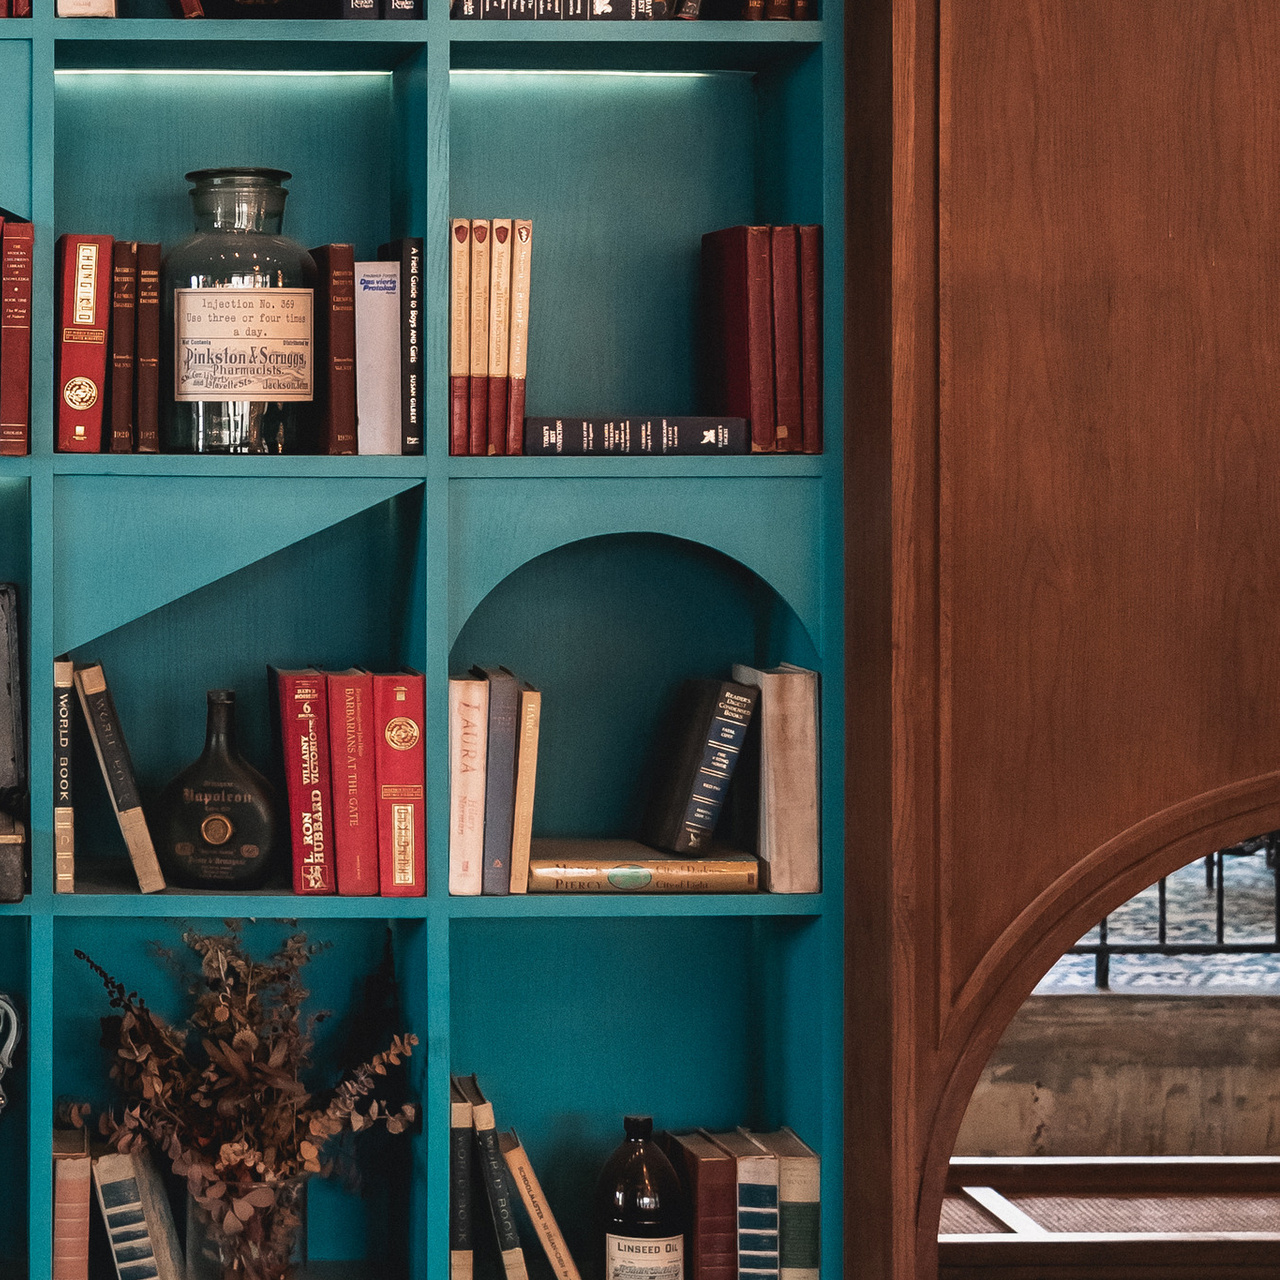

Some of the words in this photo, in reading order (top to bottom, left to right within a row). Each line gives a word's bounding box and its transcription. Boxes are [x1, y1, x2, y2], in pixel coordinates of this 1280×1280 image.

[411, 246, 419, 254] A
[411, 255, 419, 273] Field
[359, 278, 375, 286] Das
[376, 278, 397, 286] vierte
[410, 275, 419, 298] Guide
[202, 299, 254, 310] Injection
[260, 300, 275, 309] No.
[280, 299, 295, 309] 369
[186, 313, 202, 322] Use
[208, 313, 236, 322] three
[260, 314, 281, 323] four
[286, 314, 306, 323] times
[409, 310, 418, 328] Boys
[245, 327, 267, 337] day.
[184, 347, 246, 373] Pinkston
[249, 346, 258, 365] &
[259, 346, 307, 368] Scruggs,
[409, 345, 418, 363] Girls
[212, 364, 285, 376] Pharmacists.
[409, 397, 417, 424] GILBERT
[724, 692, 751, 704] READER'S
[726, 697, 747, 708] DIGEST
[718, 702, 751, 716] CONDENSED
[723, 709, 743, 720] BOOKS
[58, 693, 70, 748] WORLD
[345, 687, 357, 753] BARBARIANS
[458, 701, 481, 774] LAURA
[301, 735, 312, 785] VILLAINY
[346, 756, 357, 770] AT
[58, 757, 69, 801] BOOK
[347, 774, 357, 795] THE
[348, 798, 359, 827] GATE
[302, 812, 313, 845] RON
[312, 790, 325, 864] HUBBARD
[555, 878, 602, 889] PIERCY
[517, 1165, 545, 1220] SCHOOLMASTER
[617, 1241, 661, 1254] LINSEED
[665, 1243, 679, 1253] OIL
